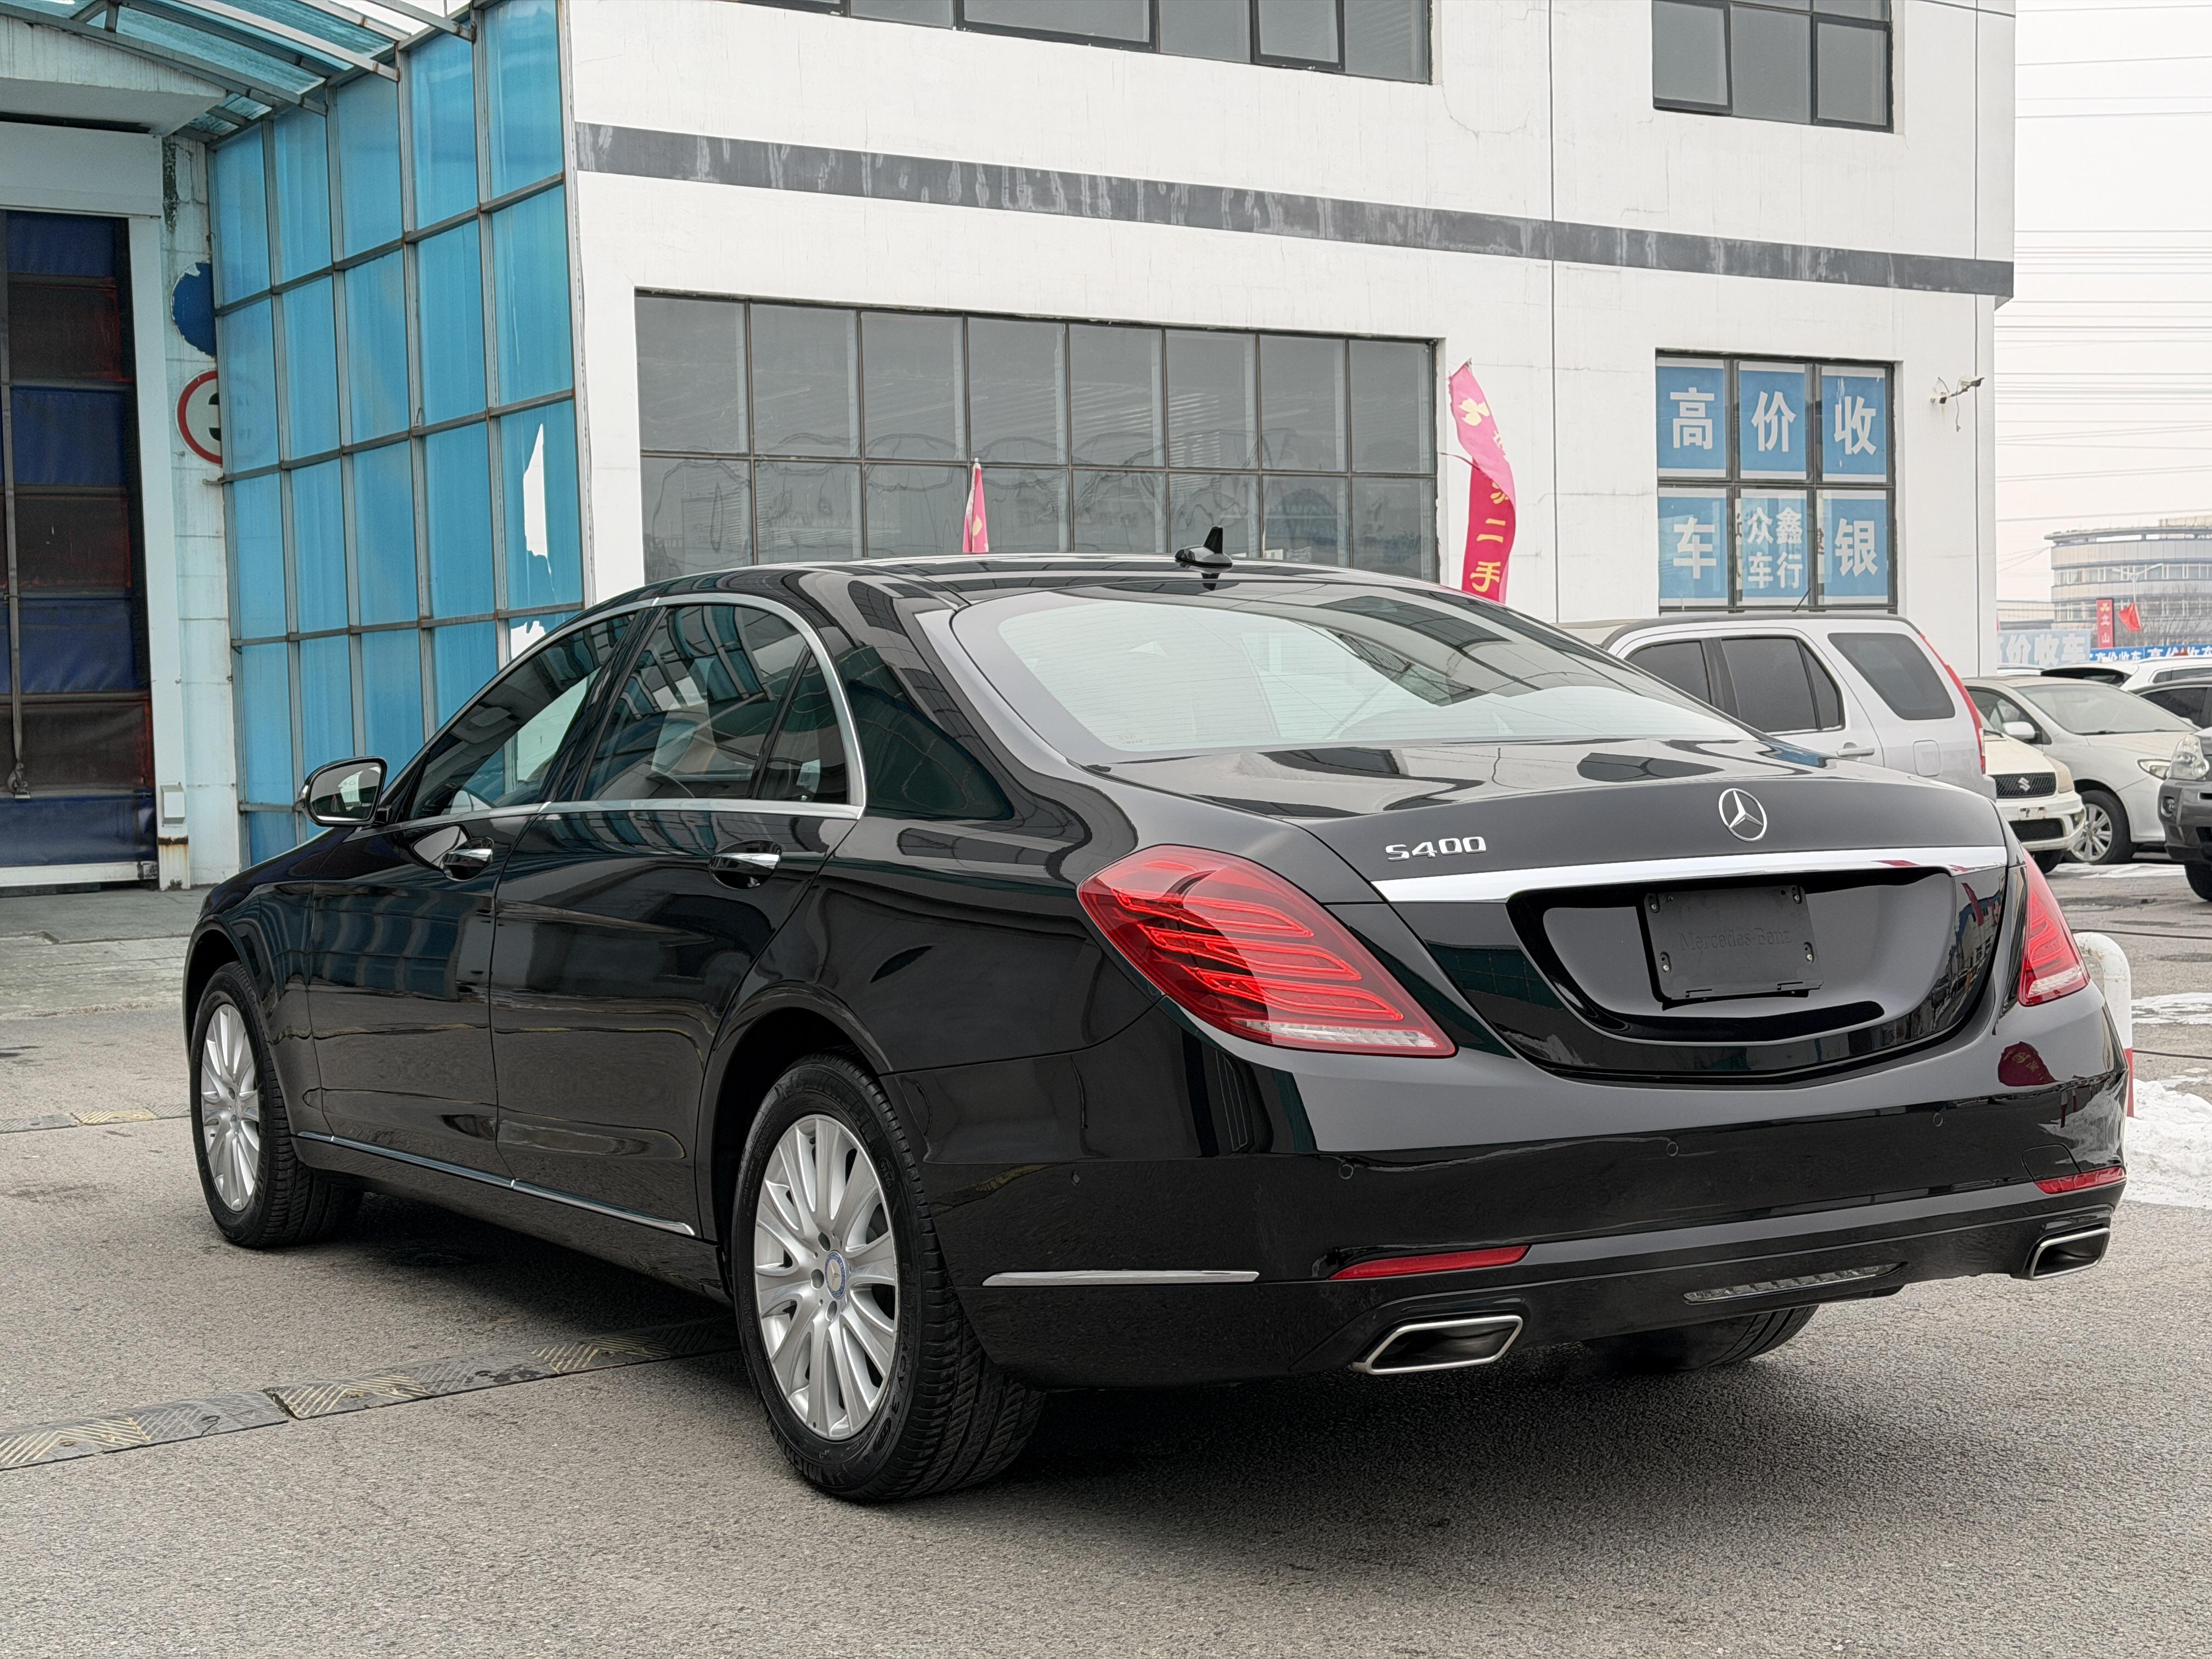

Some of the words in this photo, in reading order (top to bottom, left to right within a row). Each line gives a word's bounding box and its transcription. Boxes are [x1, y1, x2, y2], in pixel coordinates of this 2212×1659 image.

[1670, 387, 1877, 455] 高价收
[1746, 507, 1803, 544] 众鑫
[1673, 517, 1717, 579] 车
[1835, 518, 1878, 577] 银
[1747, 552, 1803, 589] 车行
[1997, 633, 2086, 667] 价收车
[1385, 837, 1486, 861] S400
